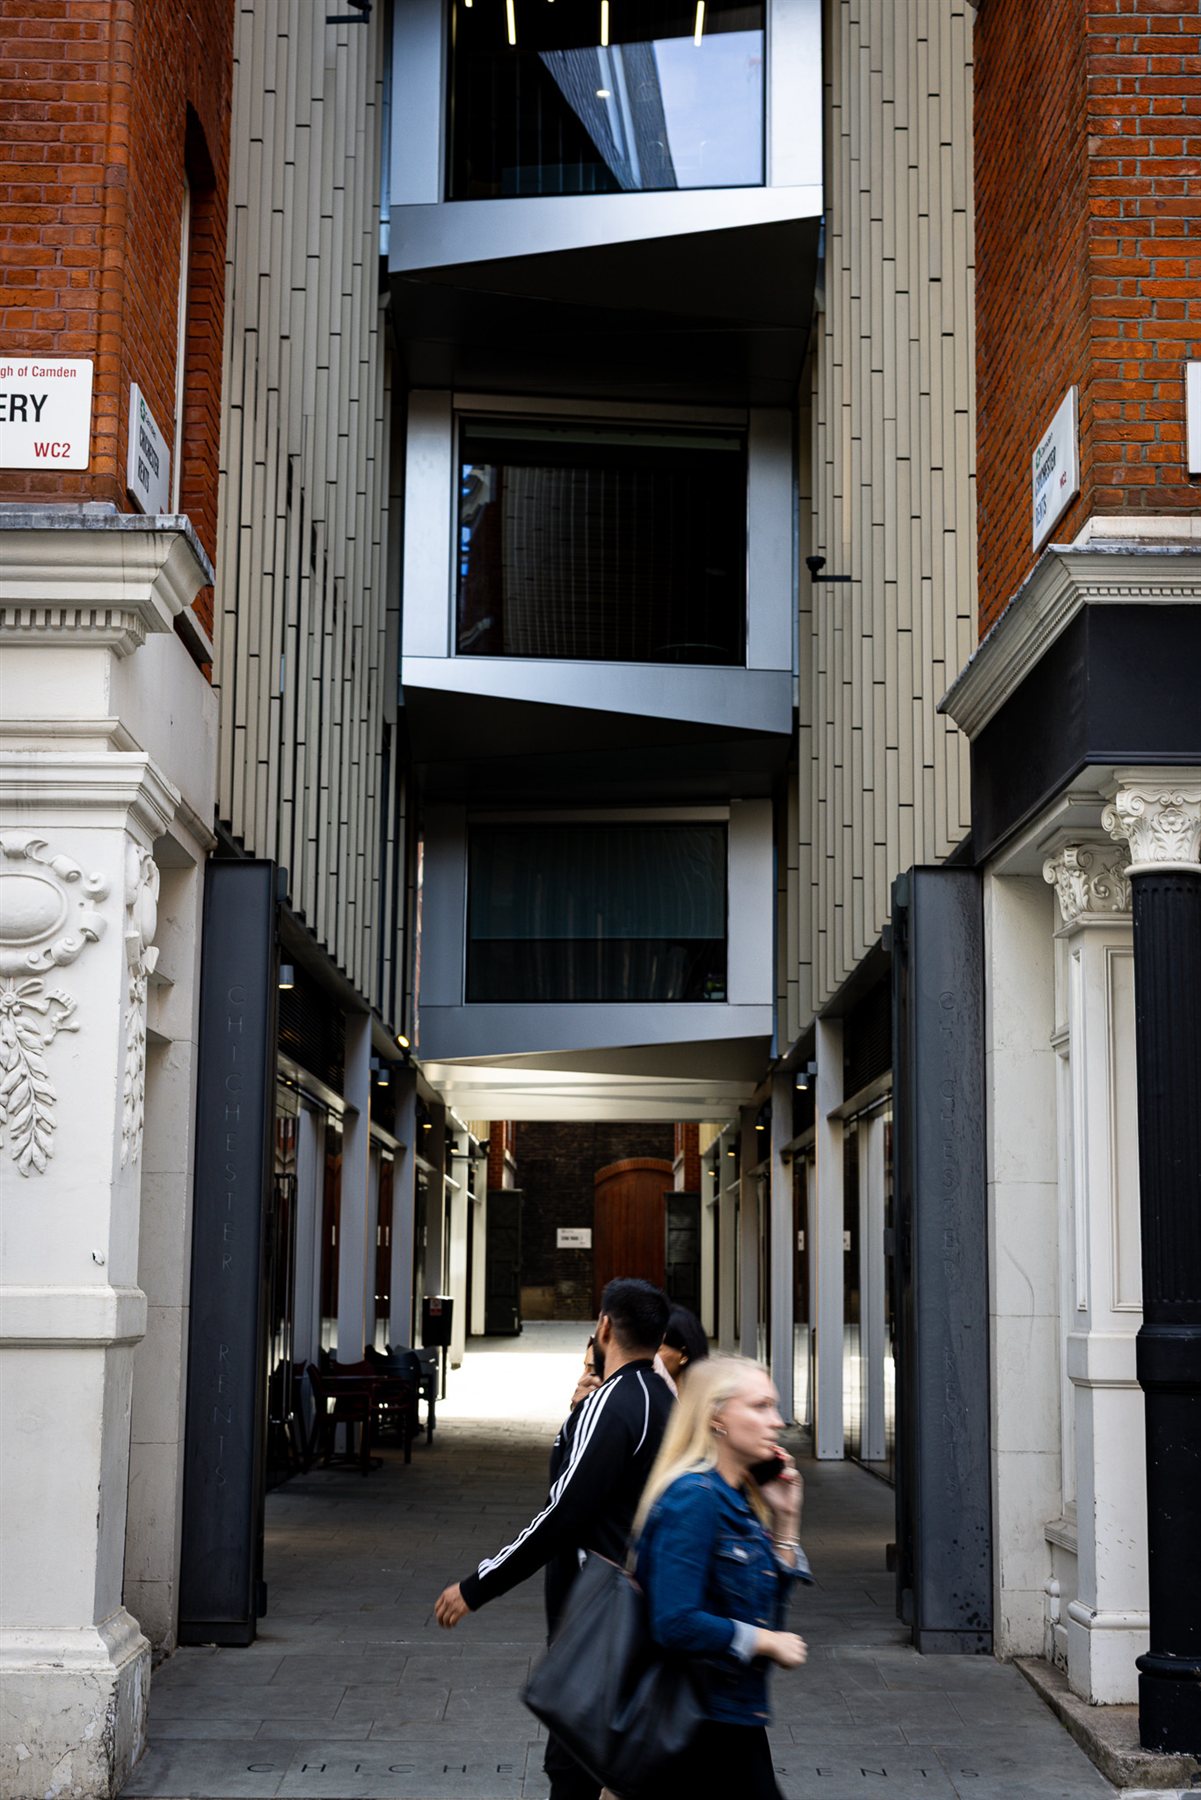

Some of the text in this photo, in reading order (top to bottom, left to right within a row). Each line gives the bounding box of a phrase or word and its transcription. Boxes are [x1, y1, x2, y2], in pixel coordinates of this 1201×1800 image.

[17, 366, 28, 377] of
[32, 366, 77, 377] Camden
[34, 442, 71, 458] WC2
[221, 985, 246, 1273] CHICHESTER
[213, 1343, 231, 1487] RENTS
[246, 1763, 980, 1778] CHICHE RENTS
